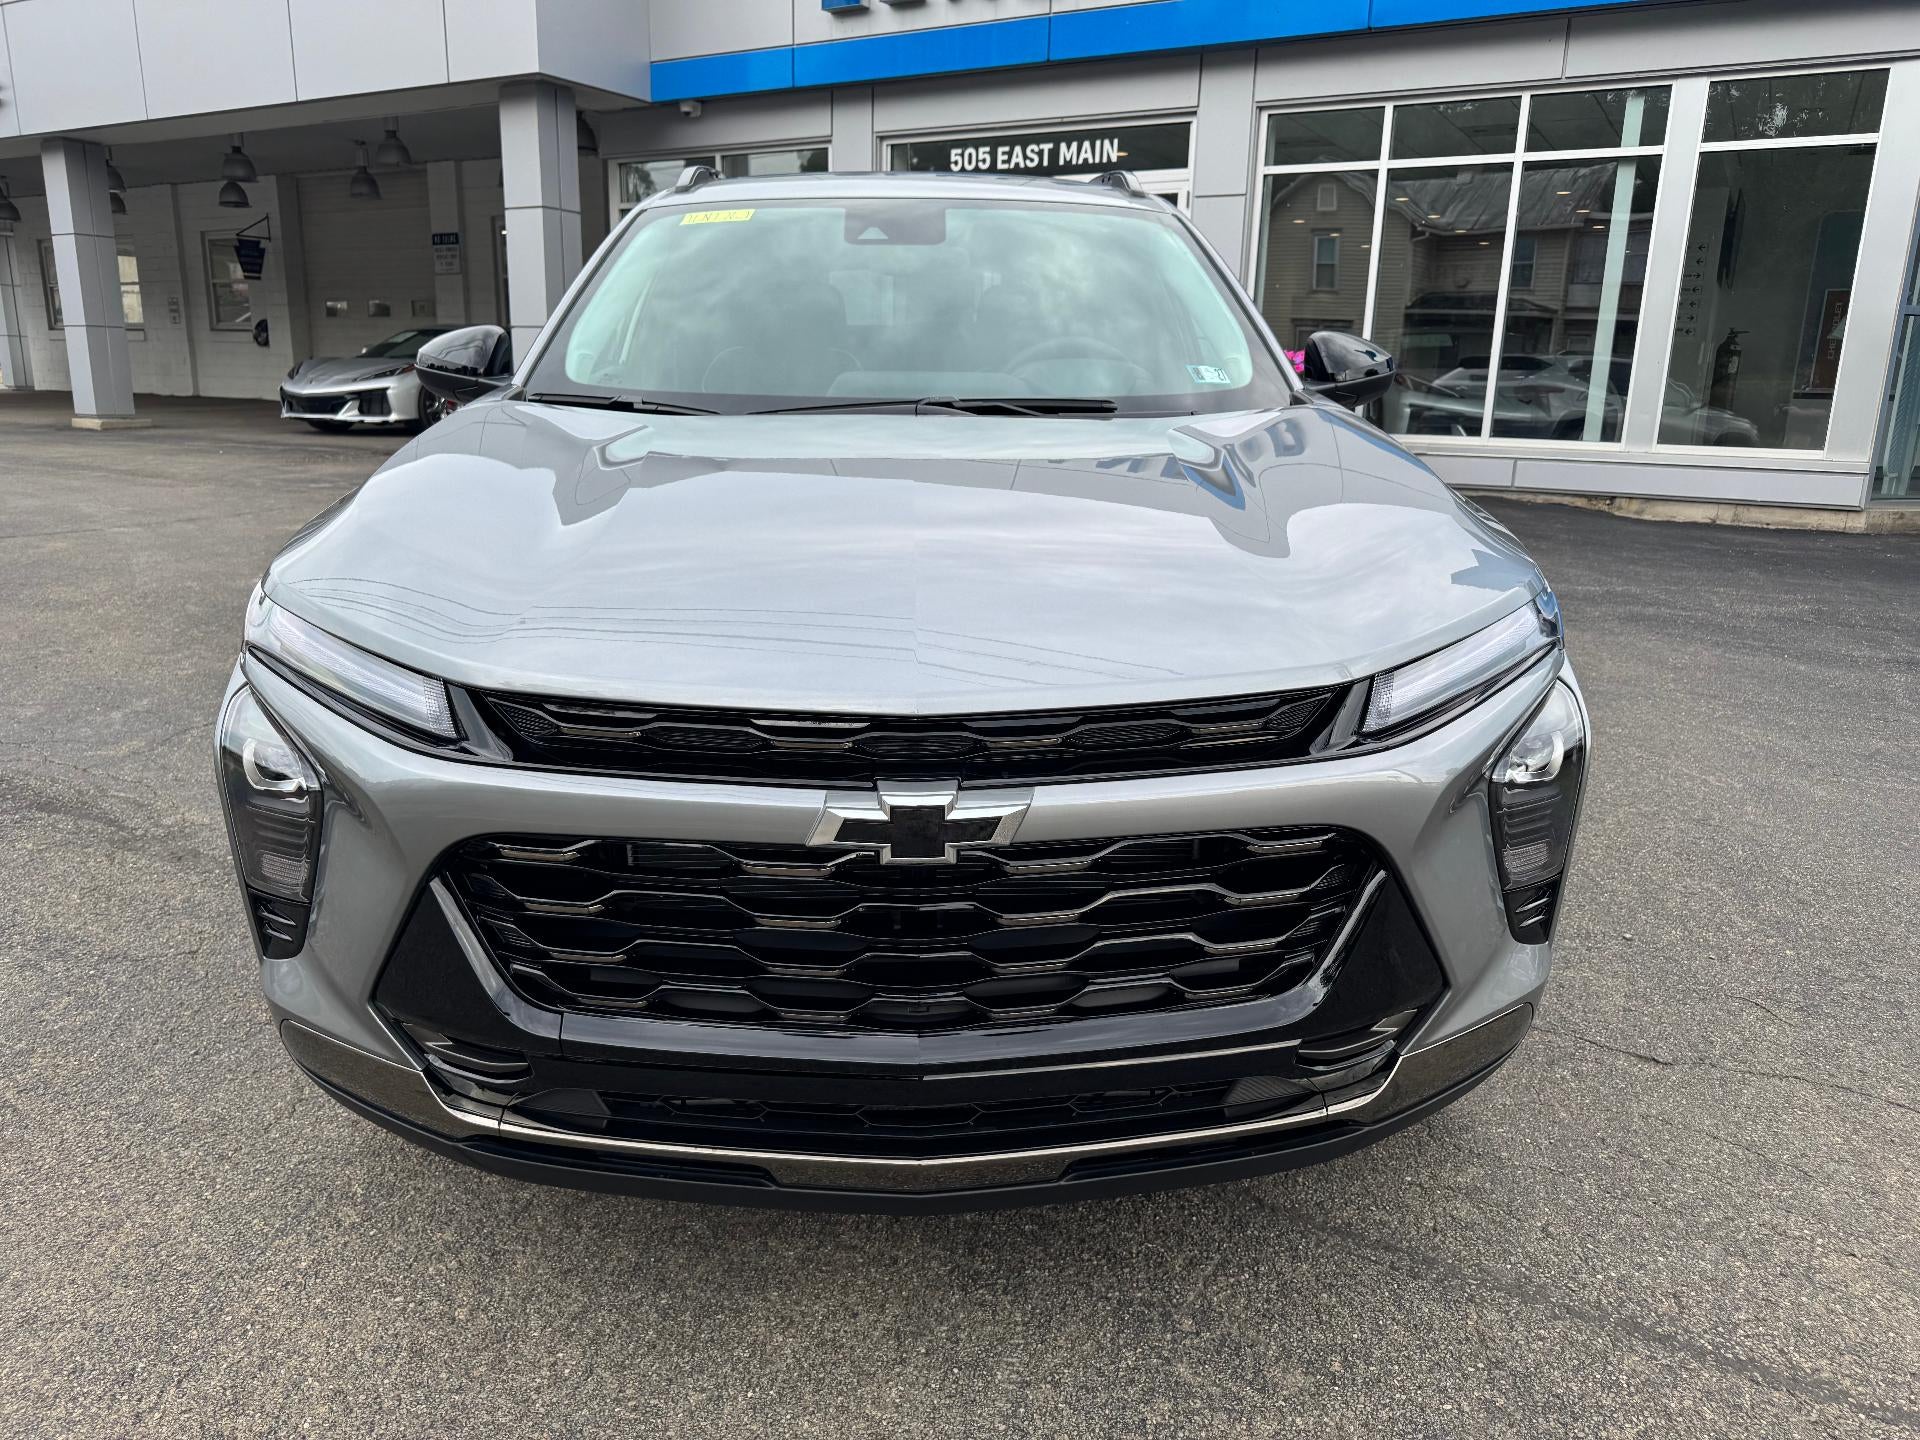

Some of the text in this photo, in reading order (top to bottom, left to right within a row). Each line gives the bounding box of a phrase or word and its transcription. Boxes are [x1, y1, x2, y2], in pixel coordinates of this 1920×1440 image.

[950, 138, 1119, 172] 505 EAST MAIN
[1828, 302, 1844, 360] CHEOLET
